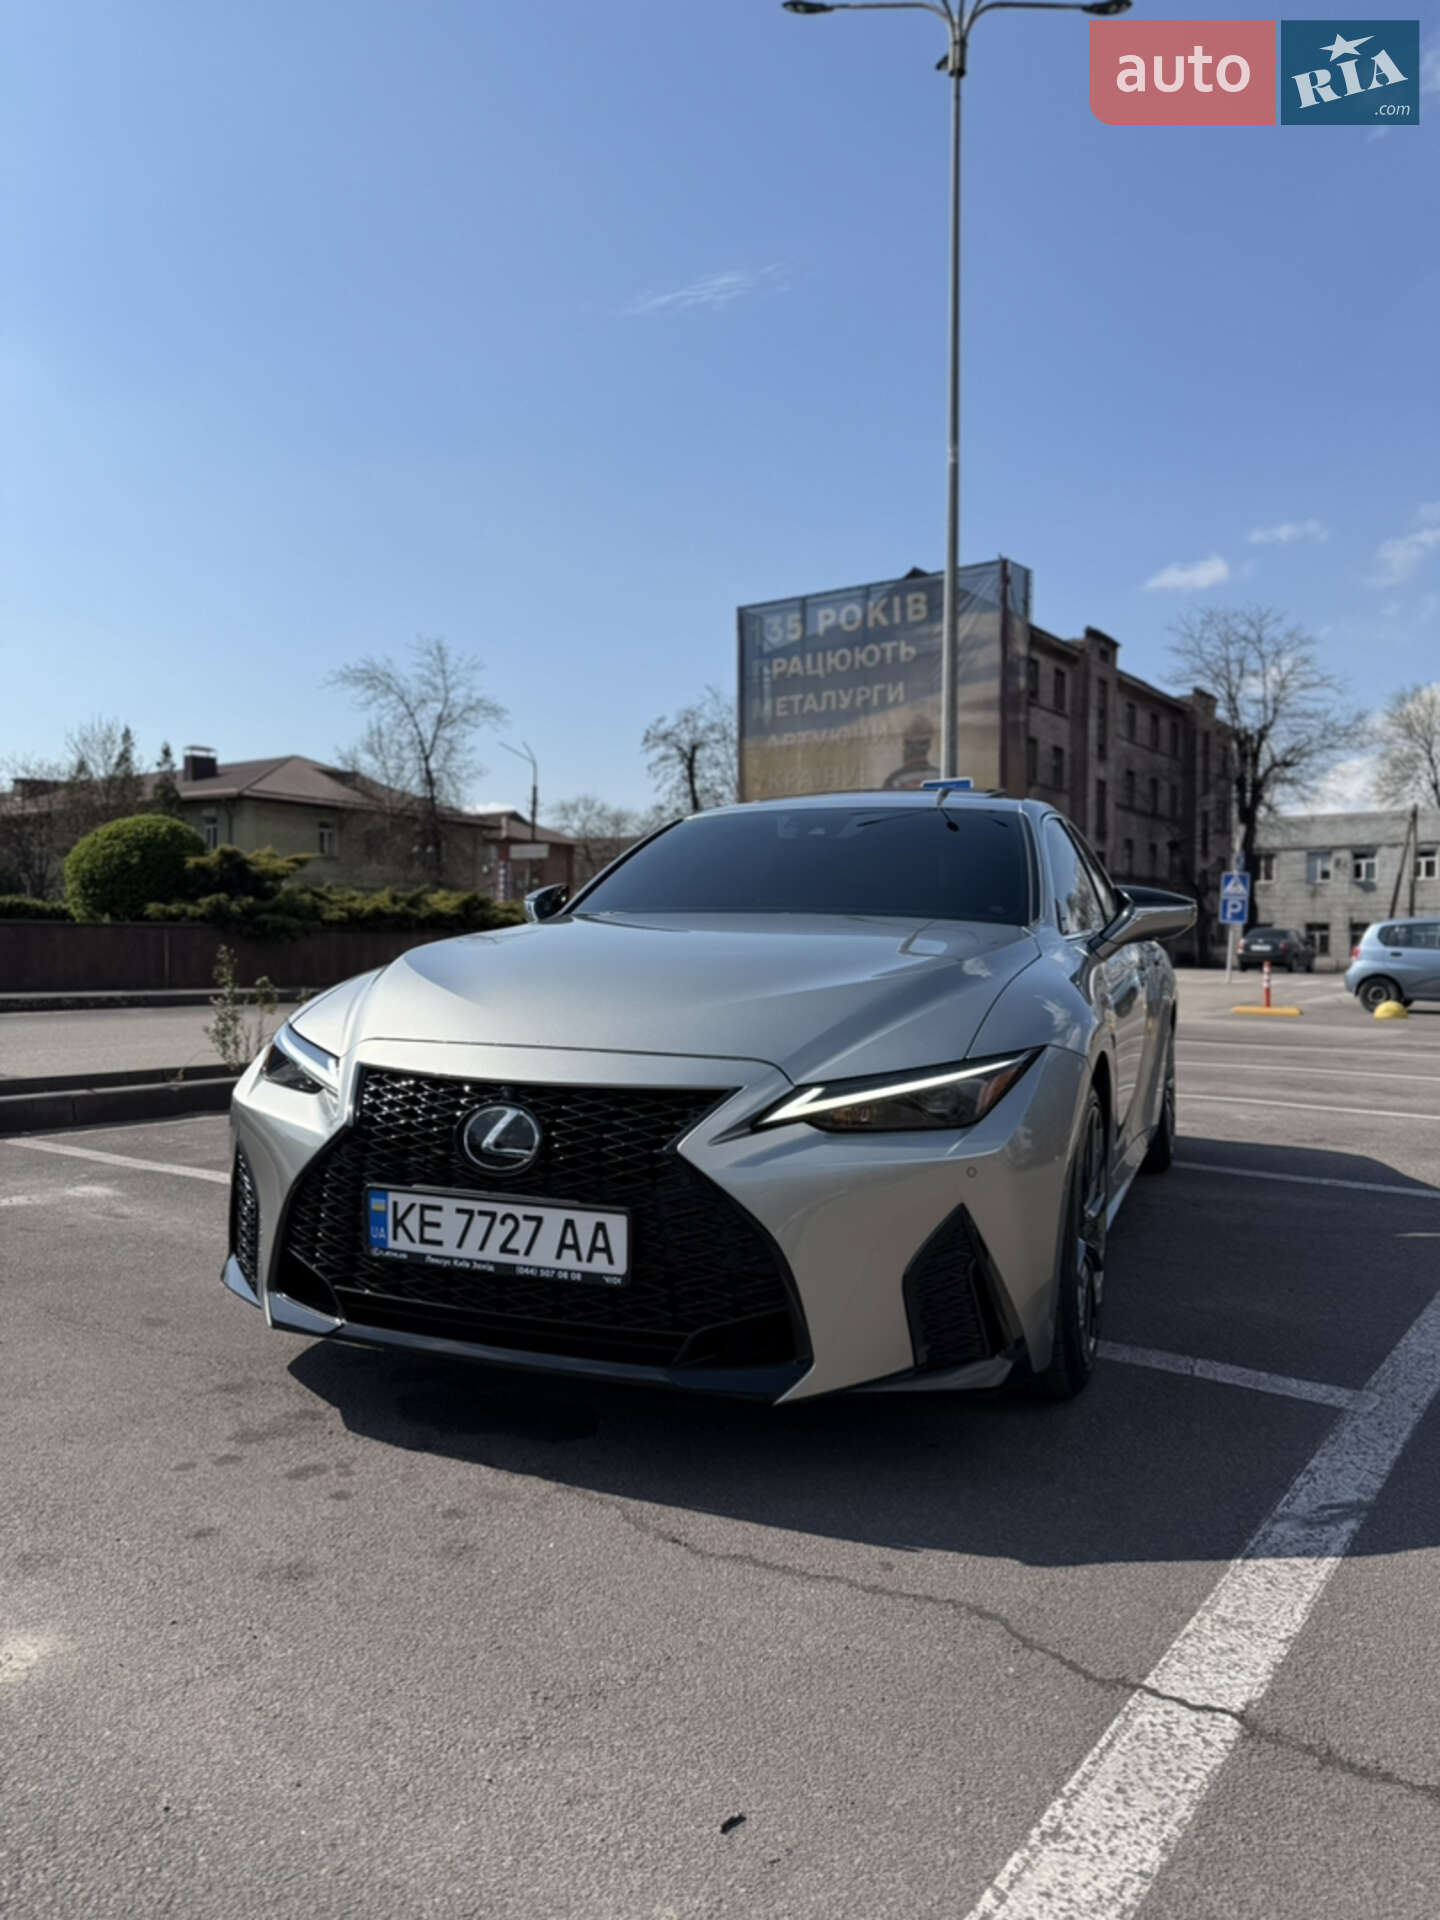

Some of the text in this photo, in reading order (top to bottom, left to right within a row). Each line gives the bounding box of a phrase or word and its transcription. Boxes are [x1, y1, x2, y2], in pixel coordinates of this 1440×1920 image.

[817, 591, 929, 637] РОКІВ
[1226, 900, 1243, 920] P
[370, 1225, 387, 1240] UA
[391, 1200, 615, 1266] KE 7727 AA
